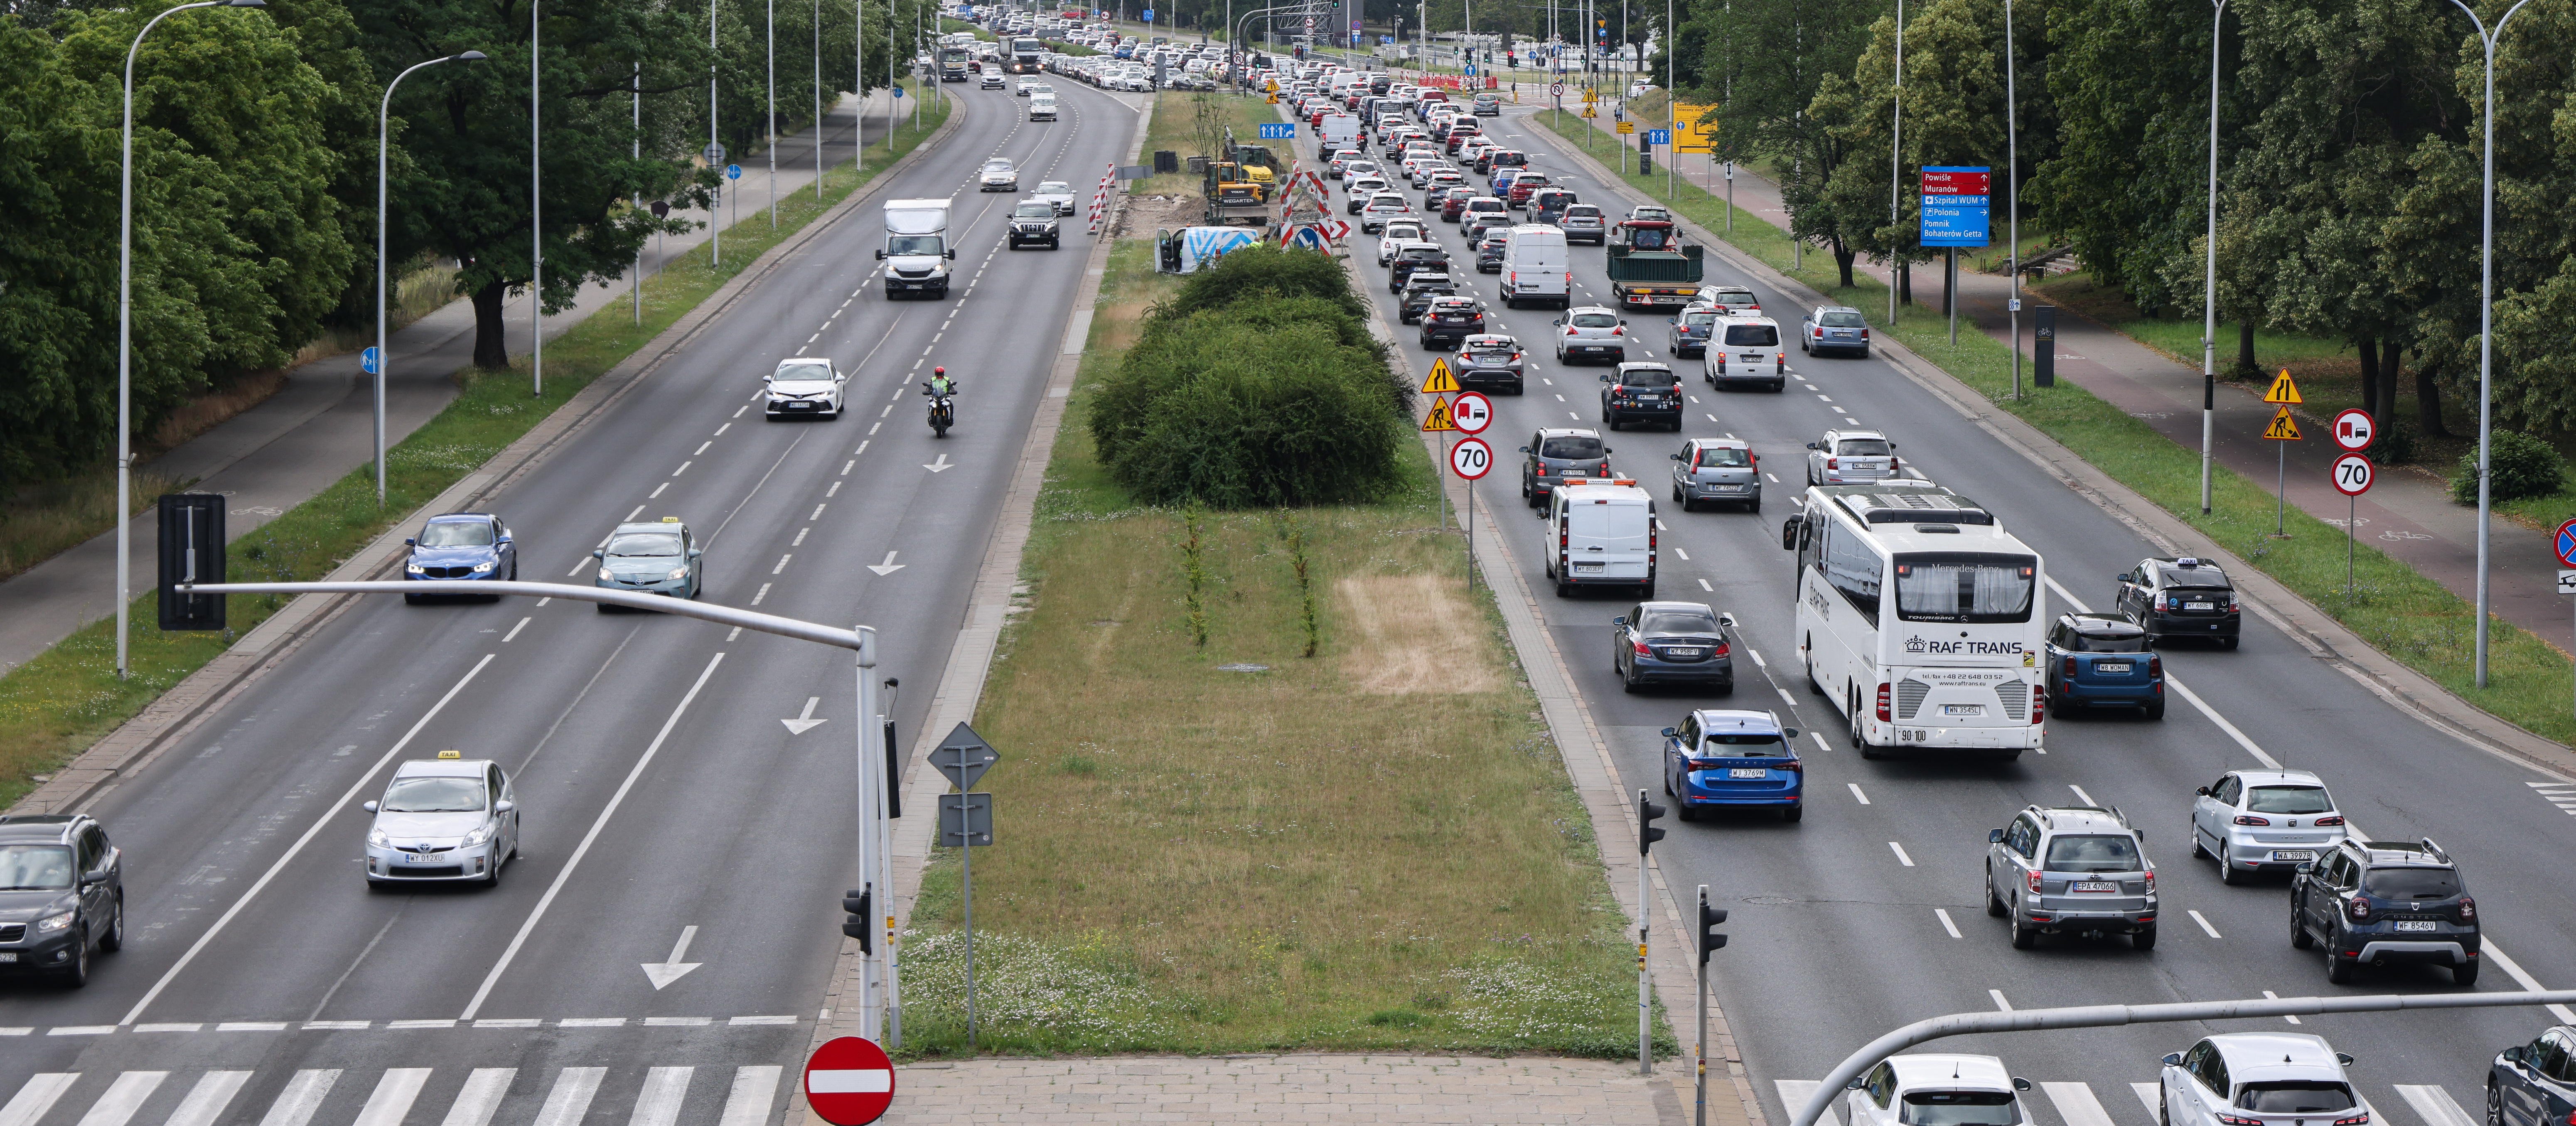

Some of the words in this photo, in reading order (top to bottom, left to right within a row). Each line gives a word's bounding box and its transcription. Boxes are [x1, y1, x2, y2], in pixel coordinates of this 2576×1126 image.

[1460, 449, 1485, 467] 70
[2340, 465, 2366, 484] 70
[1932, 563, 1999, 573] Mercedes-Benz
[1929, 642, 1961, 654] RAF
[1967, 642, 2022, 654] TRANS
[1903, 730, 1911, 741] 90
[1915, 730, 1926, 741] 100
